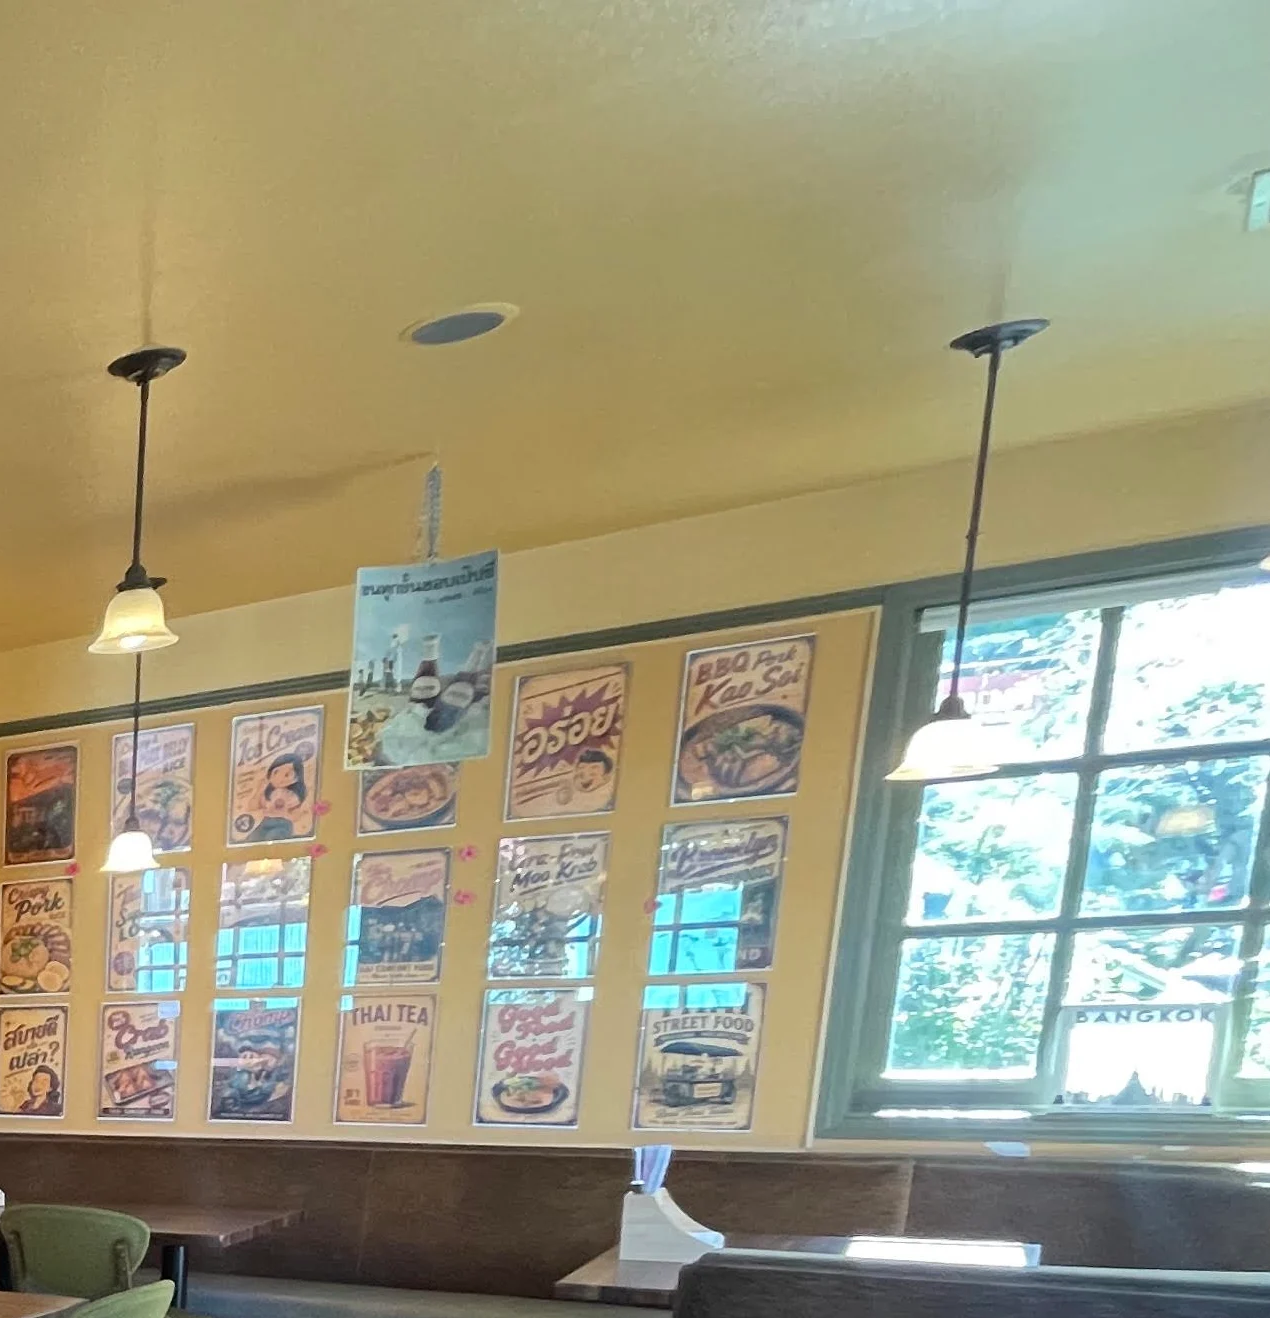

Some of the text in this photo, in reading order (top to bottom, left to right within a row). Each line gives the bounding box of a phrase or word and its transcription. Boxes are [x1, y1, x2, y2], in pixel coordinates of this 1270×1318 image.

[695, 651, 750, 686] BBQ
[694, 662, 805, 716] Kao Soi
[522, 703, 621, 764] อร่อย
[14, 891, 65, 923] Pork
[352, 1003, 429, 1026] THAI TEA
[653, 1015, 755, 1034] STREET FOOD
[1075, 1009, 1216, 1024] BANGKOK
[3, 1014, 60, 1051] สบายดี
[8, 1040, 60, 1071] เปล่า?
